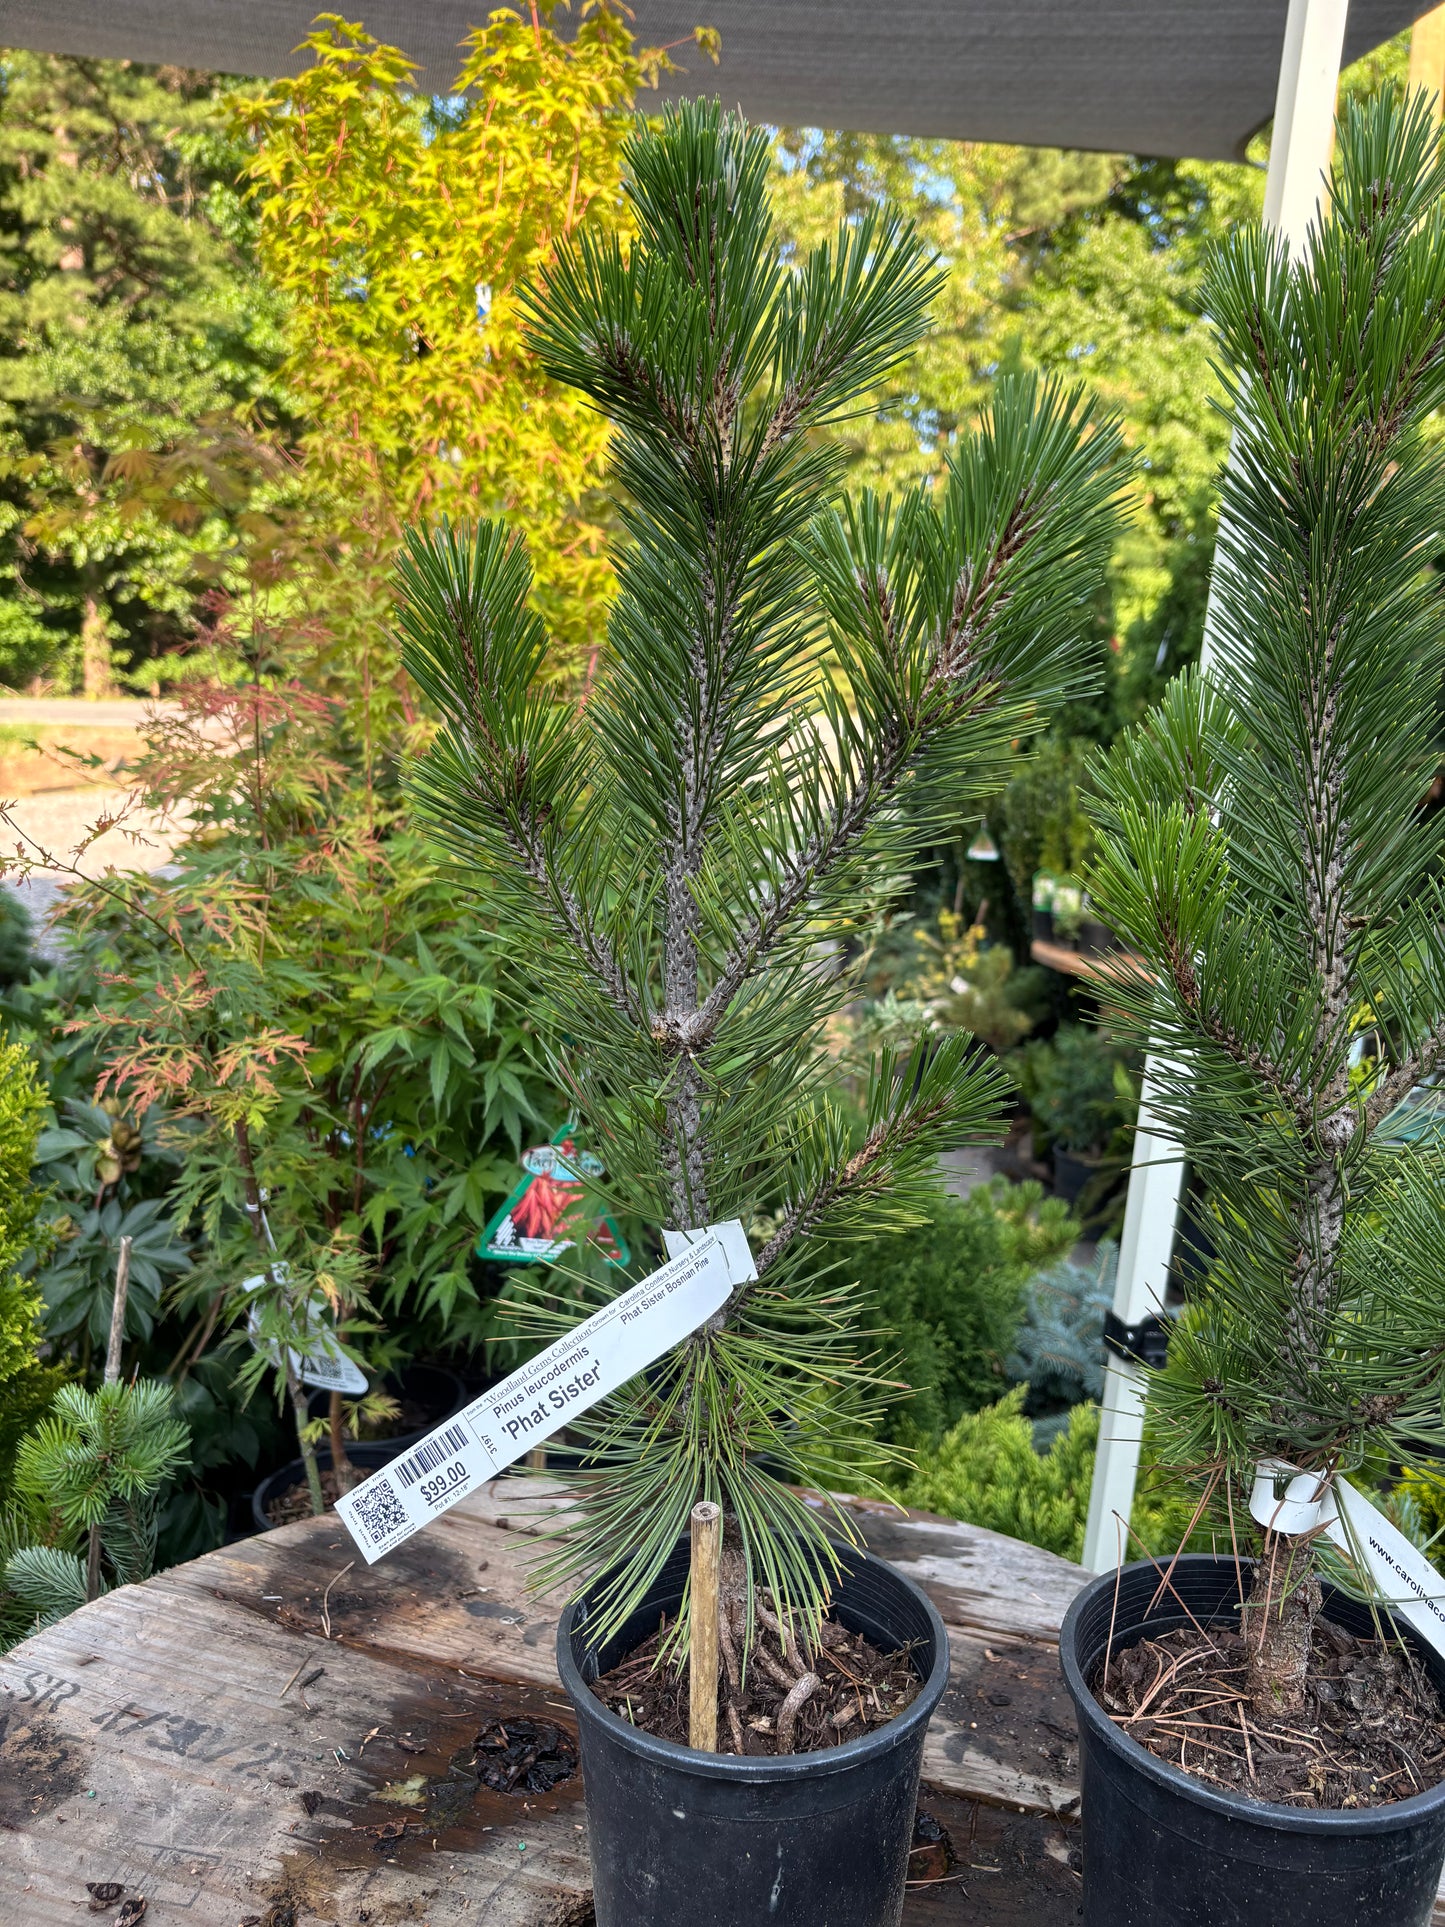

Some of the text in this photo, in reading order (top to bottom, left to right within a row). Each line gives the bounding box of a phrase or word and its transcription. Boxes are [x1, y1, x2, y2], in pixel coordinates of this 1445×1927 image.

[528, 1356, 552, 1375] Gems
[592, 1311, 609, 1328] Grown
[608, 1306, 617, 1315] for
[618, 1289, 645, 1309] Carolina
[644, 1270, 669, 1292] Conifers
[668, 1256, 690, 1275] Nursery
[688, 1252, 694, 1260] &
[693, 1235, 715, 1256] Landscape
[620, 1255, 710, 1326] Phat Sister Bosnian Pine
[492, 1345, 590, 1419] Pinus leucodermis
[501, 1359, 601, 1441] 'Phat Sister'
[481, 1434, 498, 1456] 3197
[420, 1461, 467, 1502] $99.00
[434, 1500, 445, 1512] Pot
